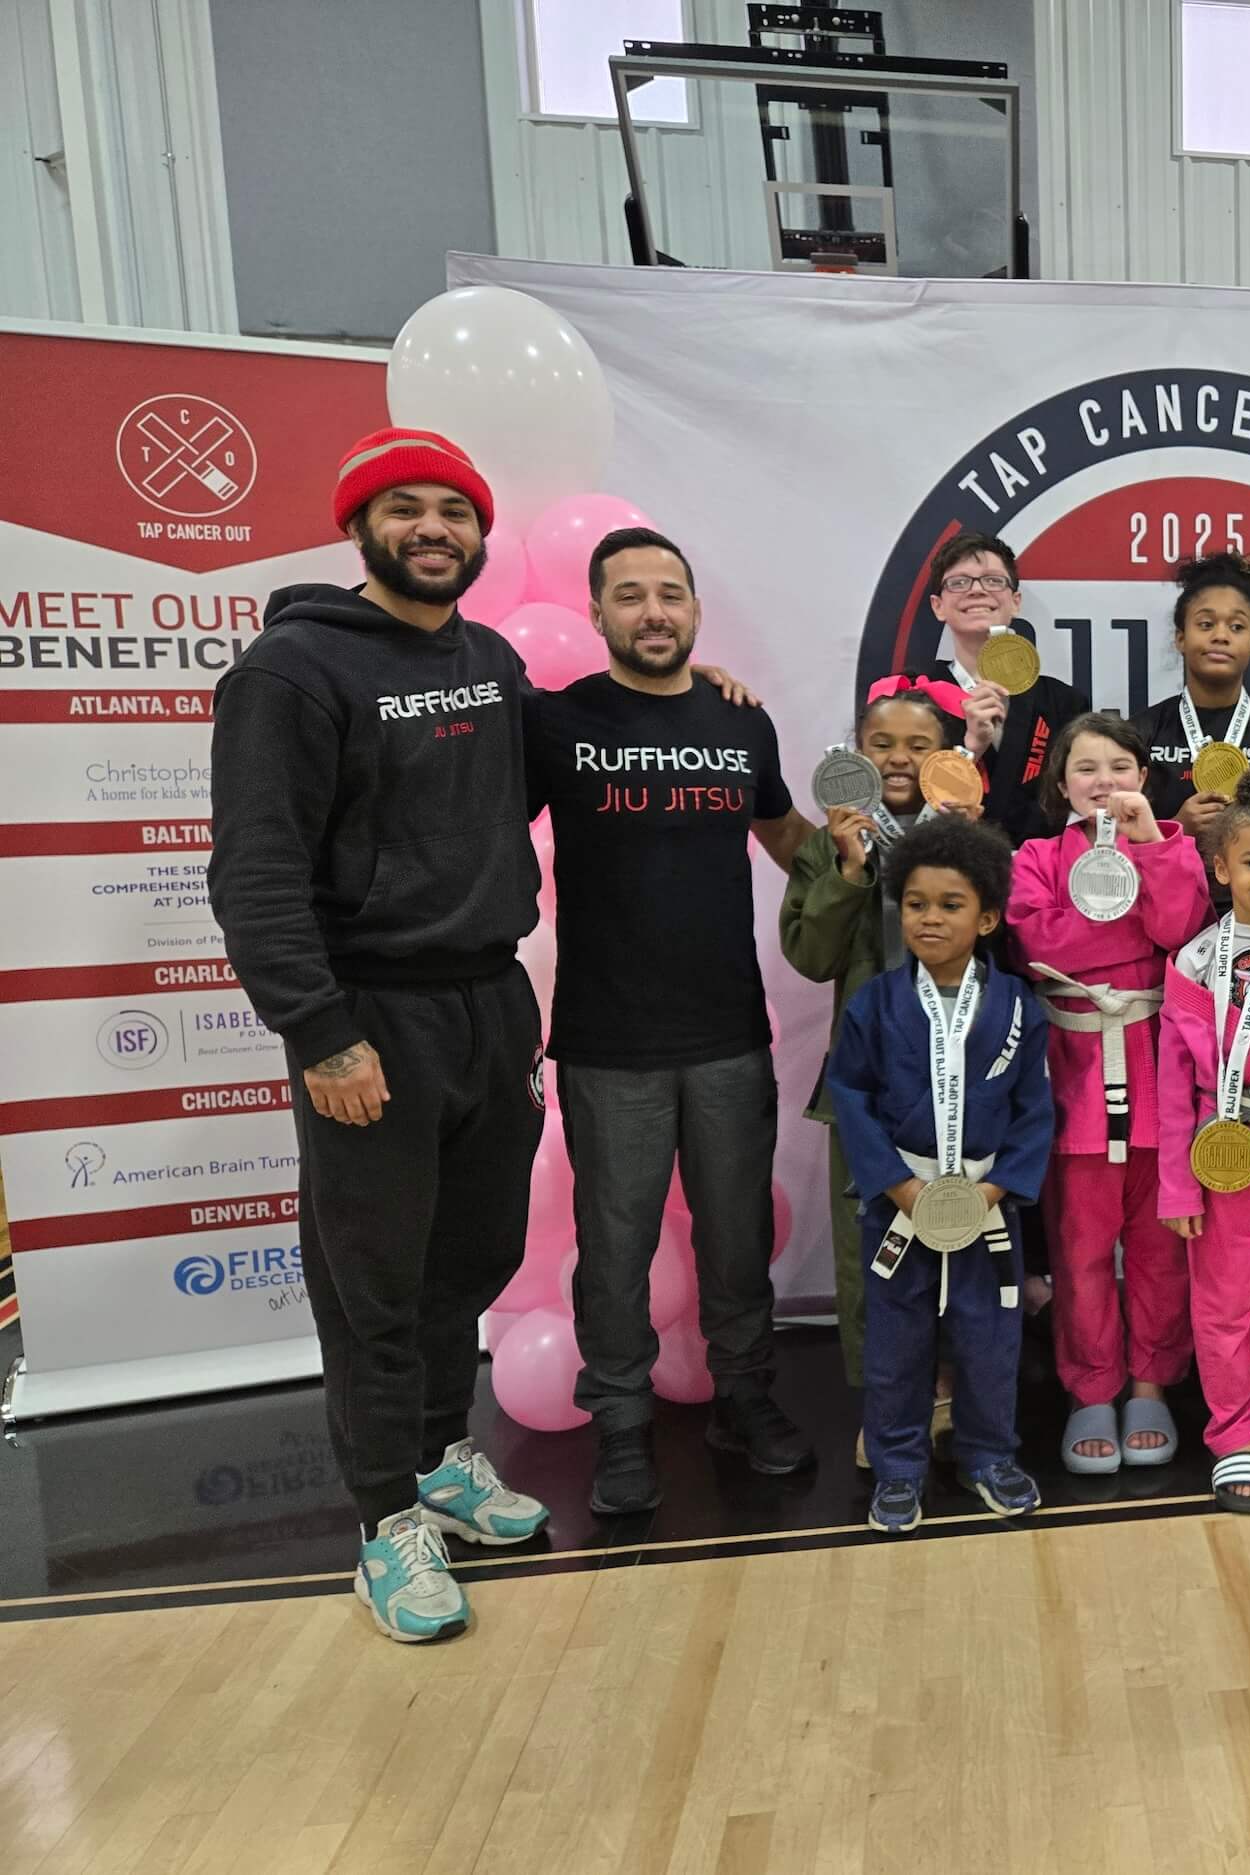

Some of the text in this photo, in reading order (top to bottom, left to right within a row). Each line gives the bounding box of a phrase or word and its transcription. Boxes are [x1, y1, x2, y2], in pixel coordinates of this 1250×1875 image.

[958, 427, 1047, 514] TAP
[138, 522, 251, 542] TAP CANCER OUT
[1130, 512, 1244, 563] 2025
[0, 591, 262, 631] MEET OUR
[0, 635, 243, 670] BENEFICI
[69, 695, 171, 716] ATLANTA,
[175, 696, 204, 715] GA
[376, 681, 503, 721] RUFFHOUSE
[433, 721, 474, 738] JIU JITSU
[575, 742, 752, 774] RUFFHOUSE
[86, 788, 98, 801] A
[101, 788, 137, 801] home
[140, 785, 158, 800] for
[161, 785, 187, 800] kids
[596, 783, 744, 813] JIU JITSU
[147, 866, 179, 877] THE
[92, 881, 208, 896] COMPREHENSI
[153, 895, 211, 908] AT JOH
[147, 936, 192, 948] Division
[195, 935, 207, 945] of
[1219, 935, 1230, 953] BJJ
[1218, 954, 1228, 978] OPEN
[957, 983, 976, 1017] CANCER
[920, 983, 934, 999] TAP
[935, 1036, 945, 1056] OUT
[953, 1017, 965, 1034] TAP
[115, 1028, 150, 1054] ISF
[948, 1074, 960, 1101] OPEN
[1227, 1069, 1241, 1095] OPEN
[182, 1089, 277, 1112] CHICAGO,
[948, 1102, 959, 1121] BJJ
[1224, 1095, 1238, 1114] BJJ
[946, 1123, 958, 1143] OUT
[113, 1155, 300, 1185] American Brain Tum
[191, 1202, 276, 1226] DENVER,
